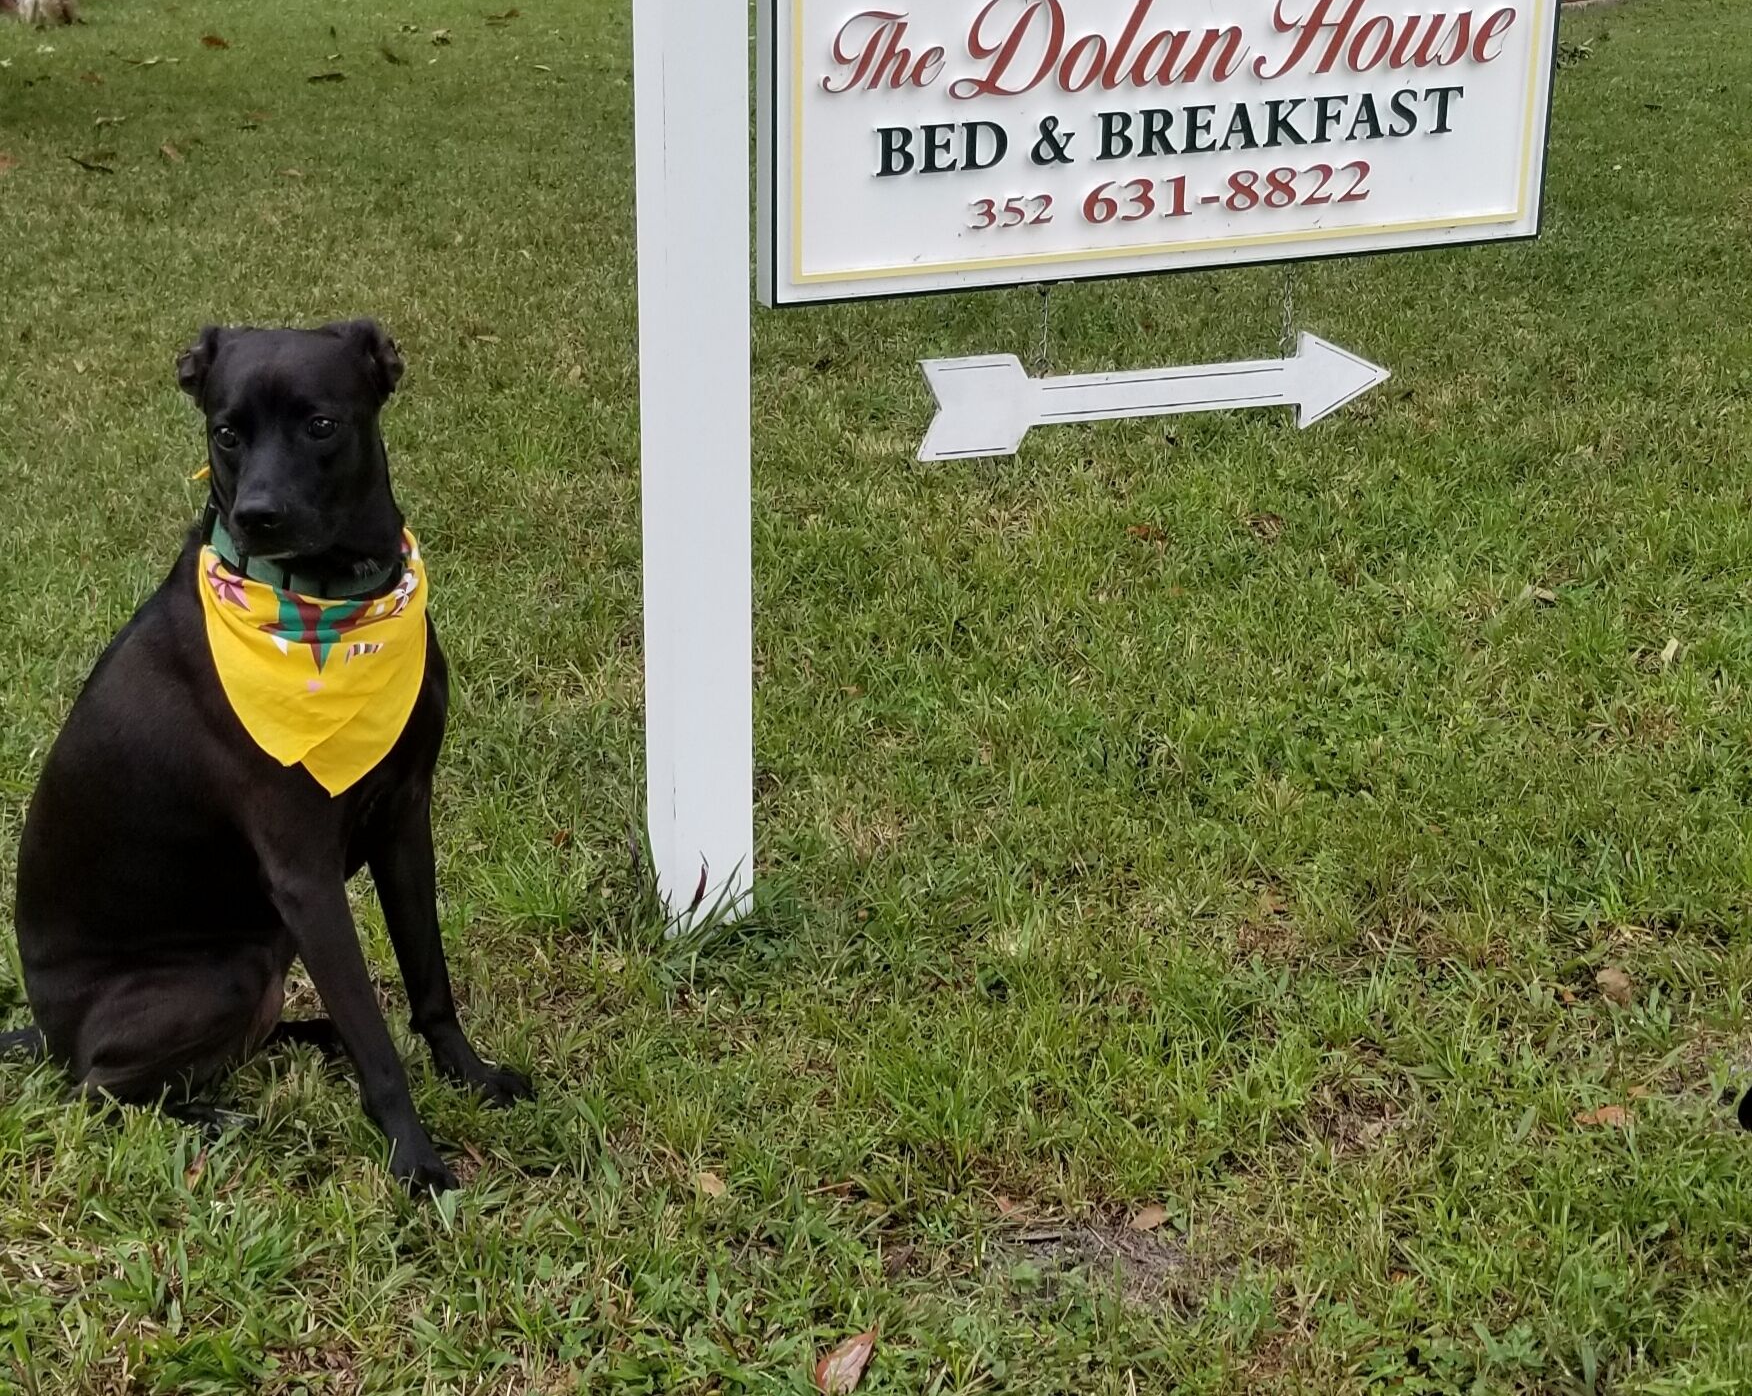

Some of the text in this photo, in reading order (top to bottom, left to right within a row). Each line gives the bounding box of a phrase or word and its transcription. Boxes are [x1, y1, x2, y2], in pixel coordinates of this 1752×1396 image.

[820, 10, 945, 94] The
[876, 87, 1464, 178] BED & BREAKFAST
[970, 162, 1371, 230] 352 631-8822
